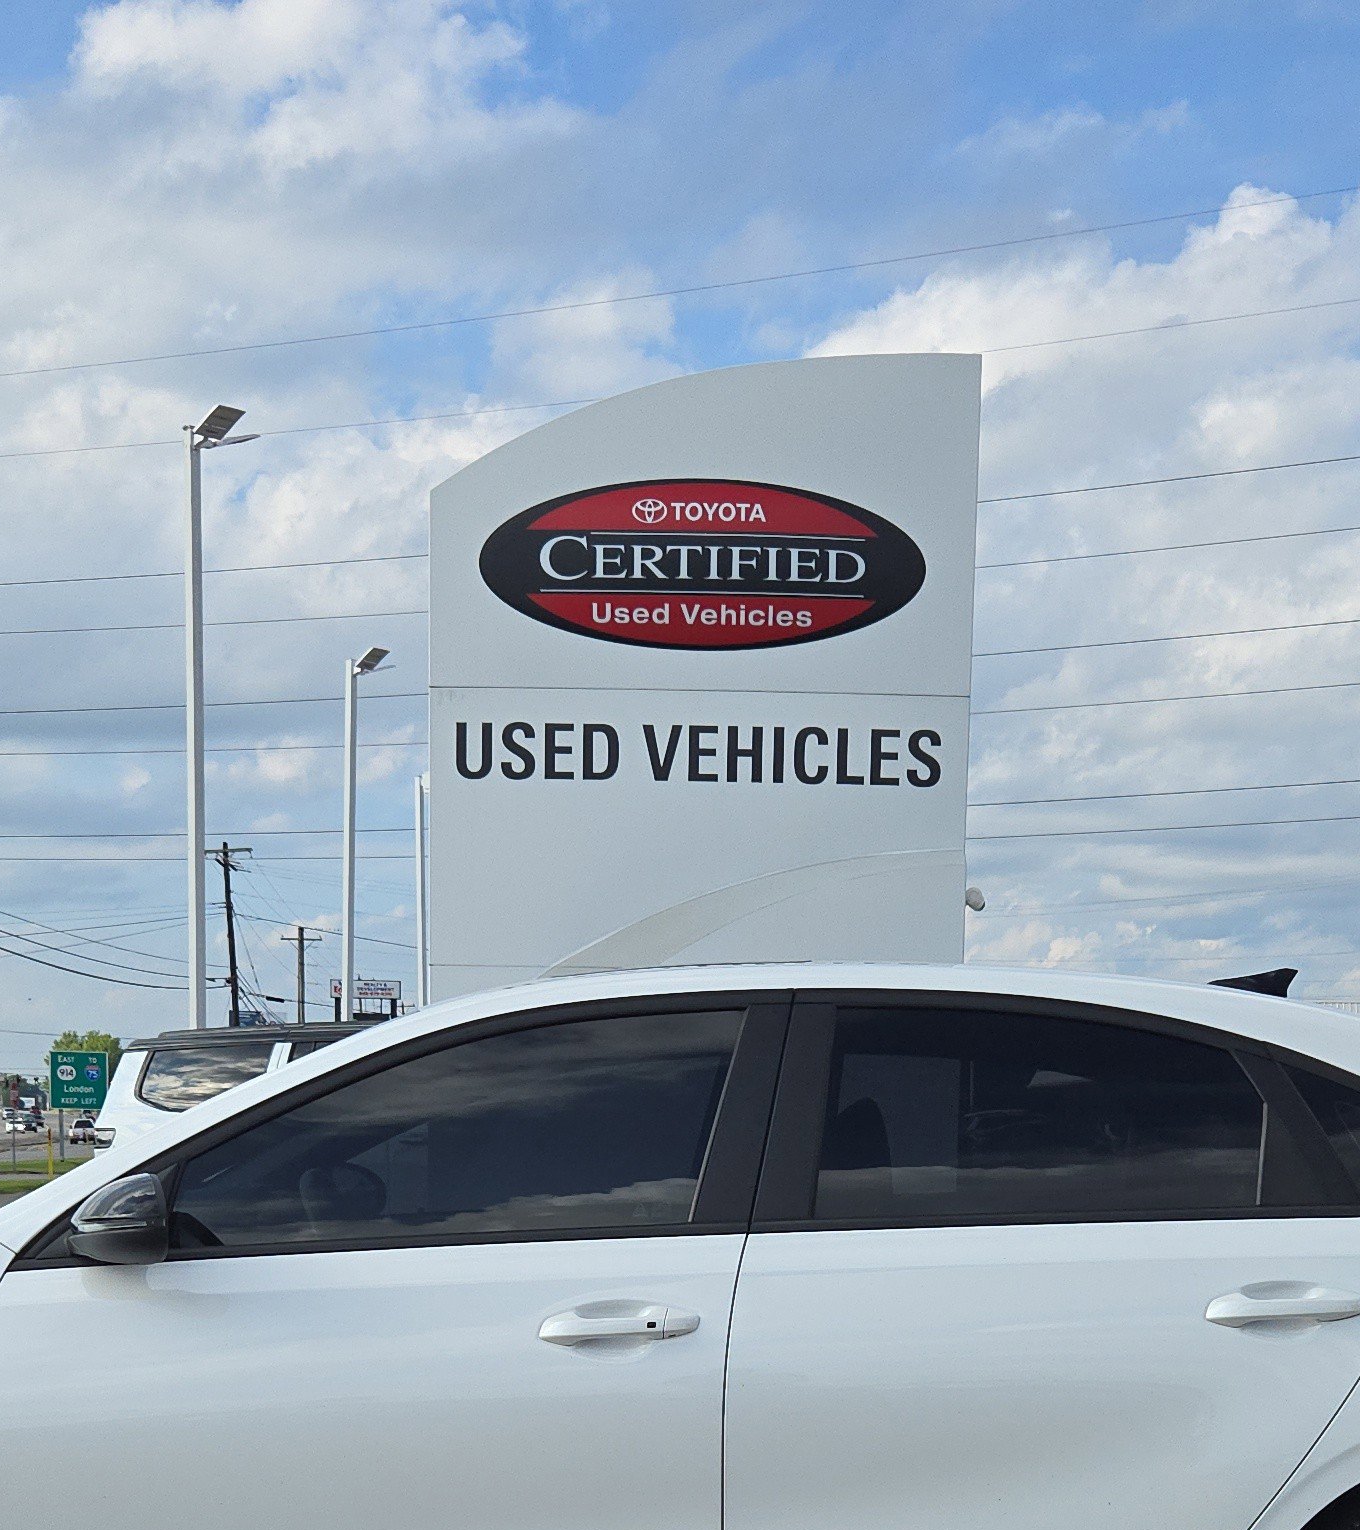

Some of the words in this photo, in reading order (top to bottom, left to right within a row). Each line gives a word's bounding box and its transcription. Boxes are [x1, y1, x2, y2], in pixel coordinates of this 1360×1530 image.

[670, 502, 767, 524] TOYOTA
[539, 534, 867, 585] CERTIFIED
[591, 602, 671, 627] Used
[680, 604, 814, 629] Vehicles
[454, 721, 620, 782] USED
[642, 724, 943, 788] VEHICLES
[57, 1054, 75, 1063] EAST
[88, 1056, 98, 1064] TO
[59, 1068, 74, 1078] 914
[87, 1070, 99, 1079] 75
[63, 1084, 95, 1094] London
